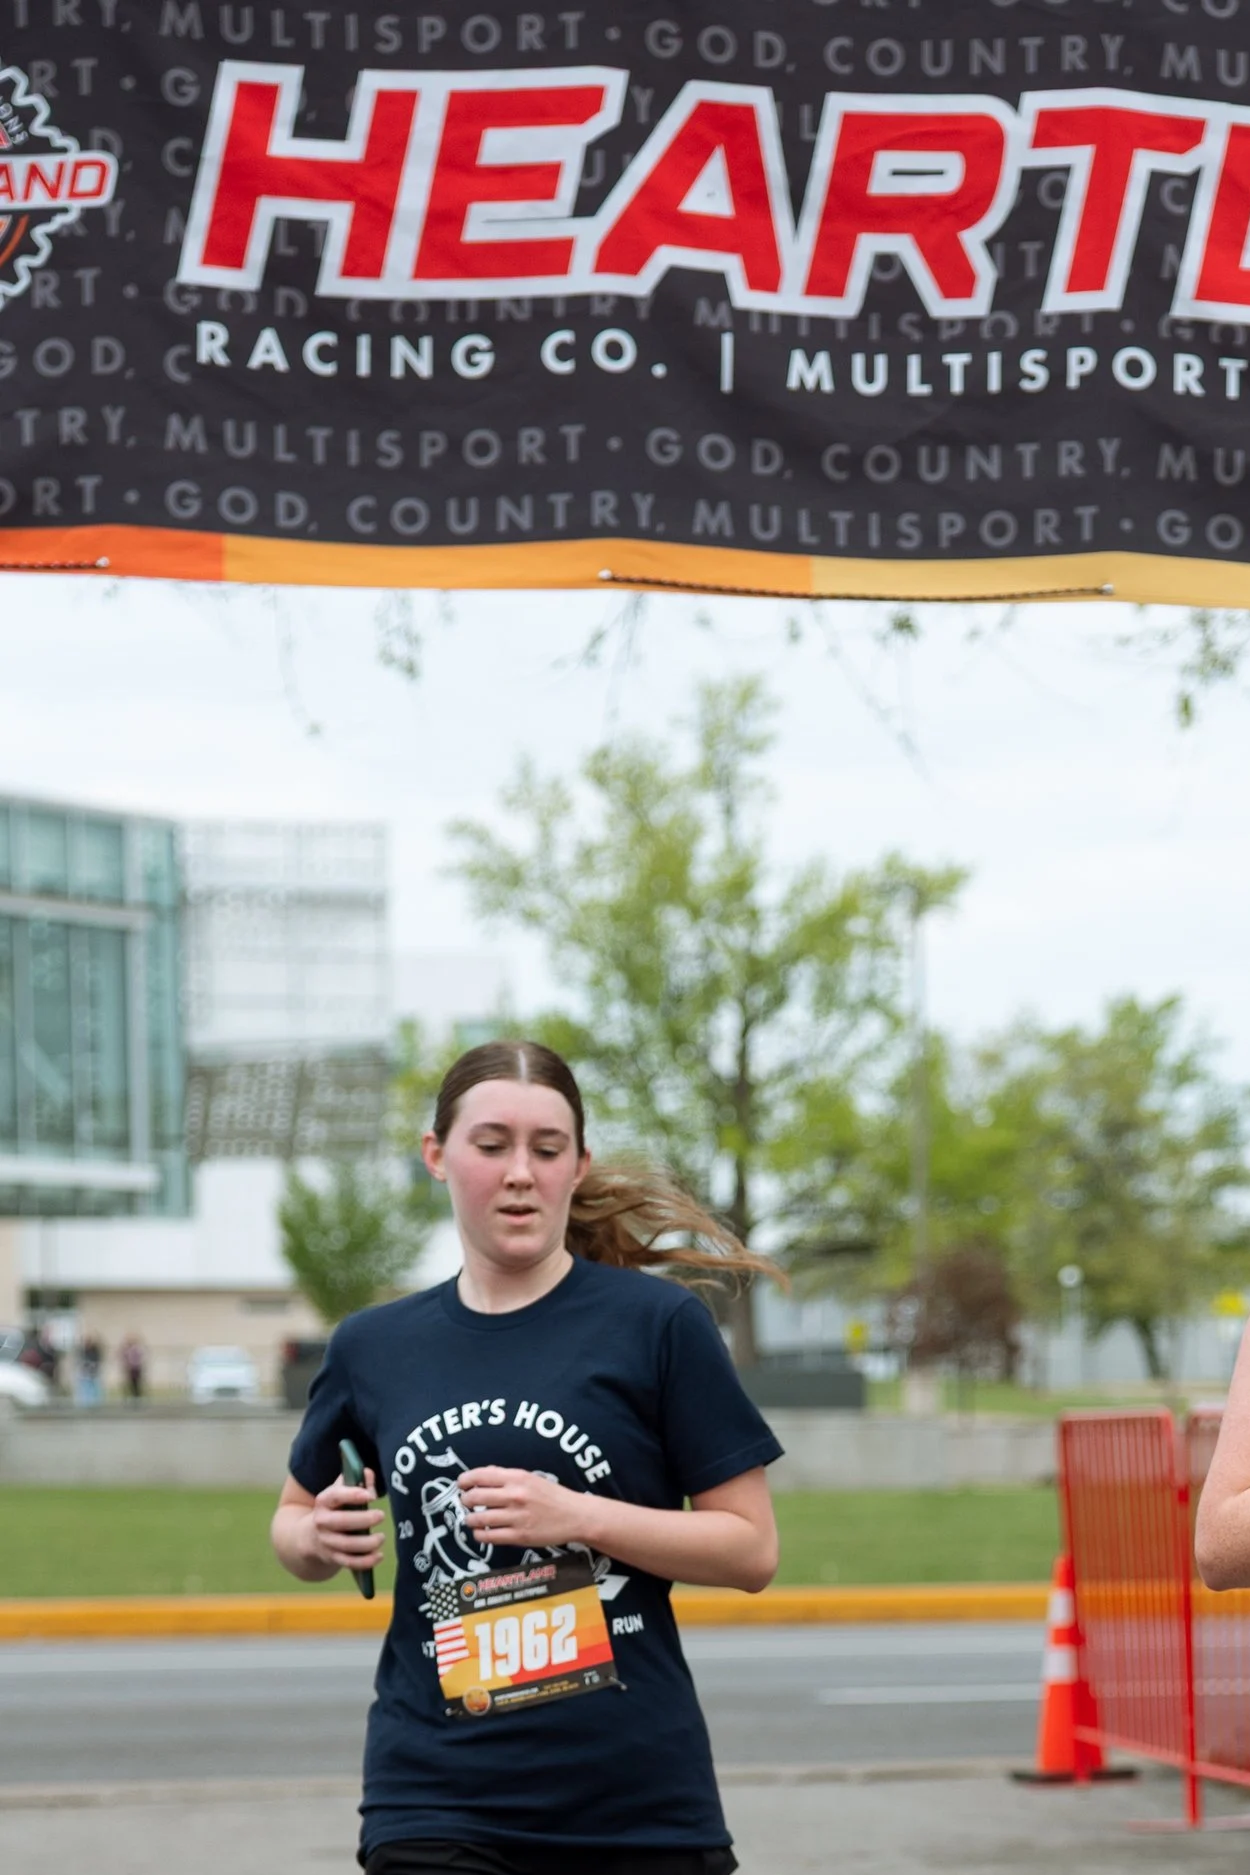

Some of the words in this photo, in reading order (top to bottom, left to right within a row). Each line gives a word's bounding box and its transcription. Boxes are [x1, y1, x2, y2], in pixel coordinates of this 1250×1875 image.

[160, 1, 585, 54] MULTISPORT
[645, 20, 797, 74] GOD,
[823, 34, 1133, 77] COUNTRY,
[196, 320, 496, 380] RACING
[540, 327, 668, 379] CO.
[786, 345, 1249, 400] MULTISPORT
[165, 412, 586, 469] MULTISPORT
[645, 427, 794, 480] GOD,
[821, 437, 1131, 483] COUNTRY,
[164, 479, 318, 534] GOD,
[346, 490, 666, 536] COUNTRY,
[692, 499, 1099, 550] MULTISPORT
[391, 1397, 506, 1495] POTTER'S
[513, 1400, 612, 1484] HOUSE
[474, 1603, 578, 1681] 1962
[612, 1612, 645, 1636] RUN
